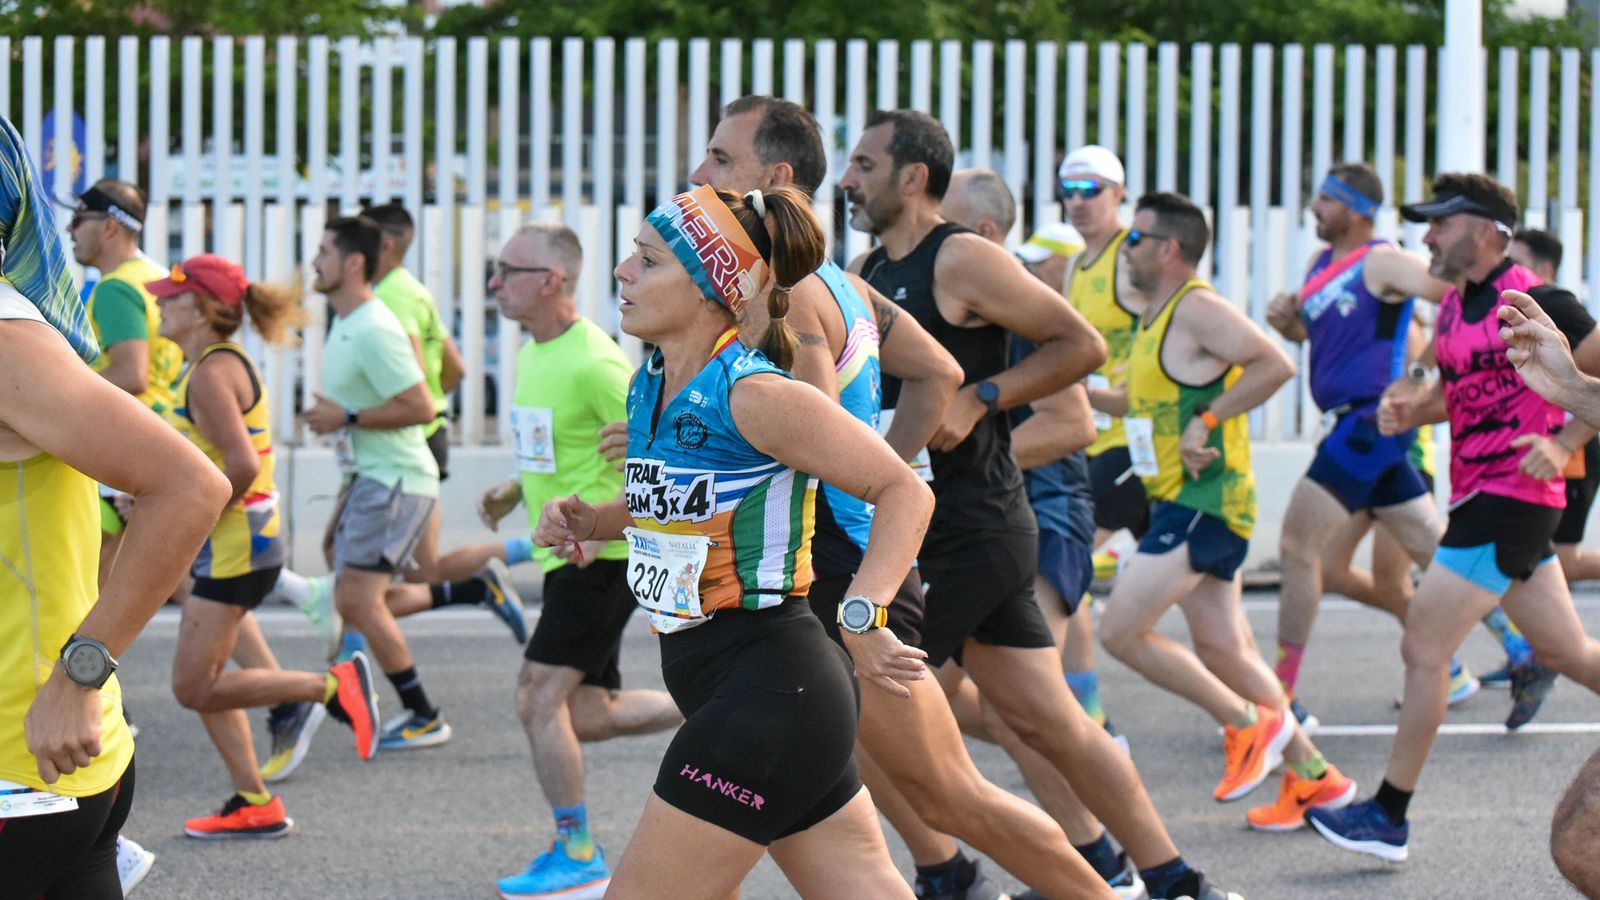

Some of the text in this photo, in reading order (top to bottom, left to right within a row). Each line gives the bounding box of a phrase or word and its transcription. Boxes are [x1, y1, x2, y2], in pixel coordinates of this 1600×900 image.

[627, 463, 661, 487] TRAIL
[626, 493, 651, 513] EAM
[668, 541, 697, 551] NATALIA
[634, 562, 669, 603] 230
[680, 764, 765, 810] HANKER
